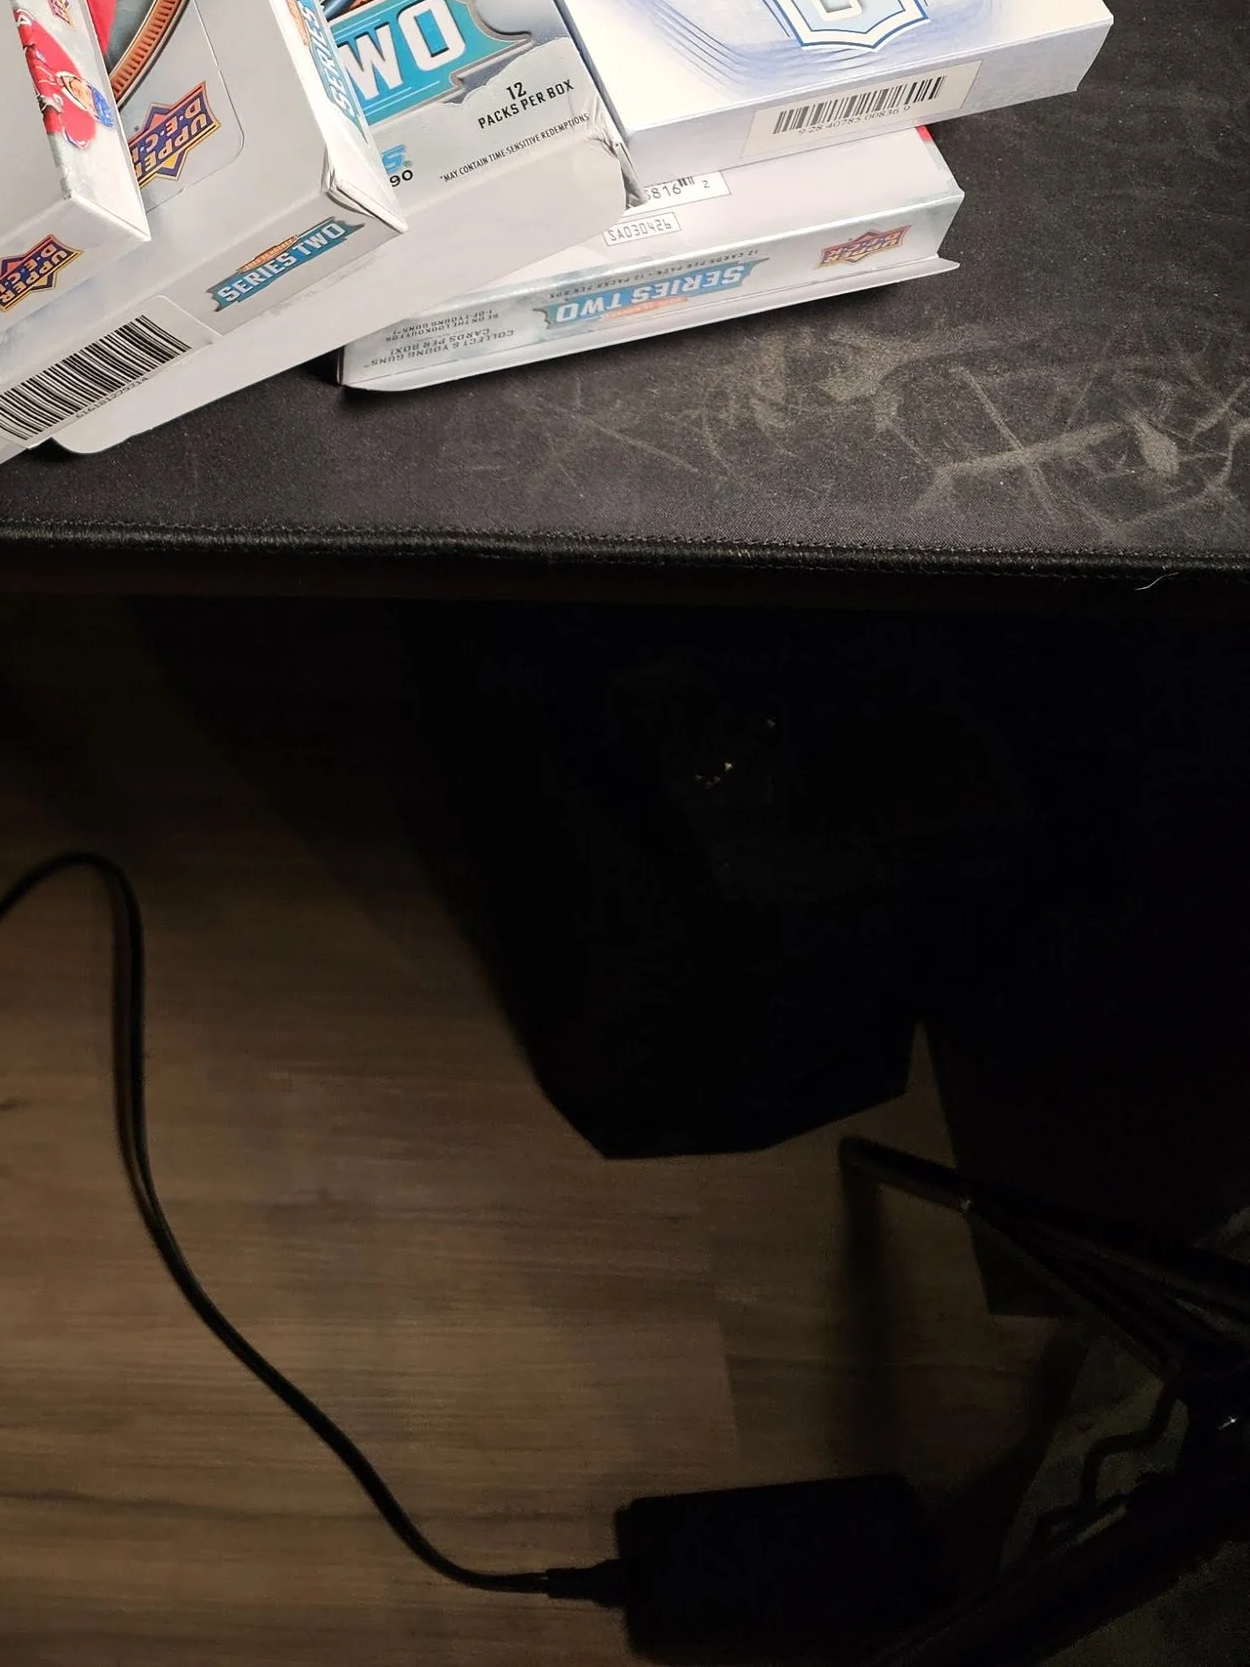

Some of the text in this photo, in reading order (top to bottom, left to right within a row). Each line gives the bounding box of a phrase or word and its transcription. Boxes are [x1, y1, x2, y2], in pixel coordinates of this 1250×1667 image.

[314, 5, 356, 118] SERIES
[478, 79, 574, 129] PACKS PER BOX
[506, 81, 527, 101] 12
[459, 157, 488, 177] CONTAIN
[488, 134, 540, 163] TIME-SENSITIVE
[540, 113, 590, 140] REDEMPTIONS
[0, 248, 69, 306] UPPER
[217, 251, 298, 304] SERIES
[292, 222, 347, 259] TWO
[631, 264, 745, 305] SERIES
[556, 289, 627, 323] TWO
